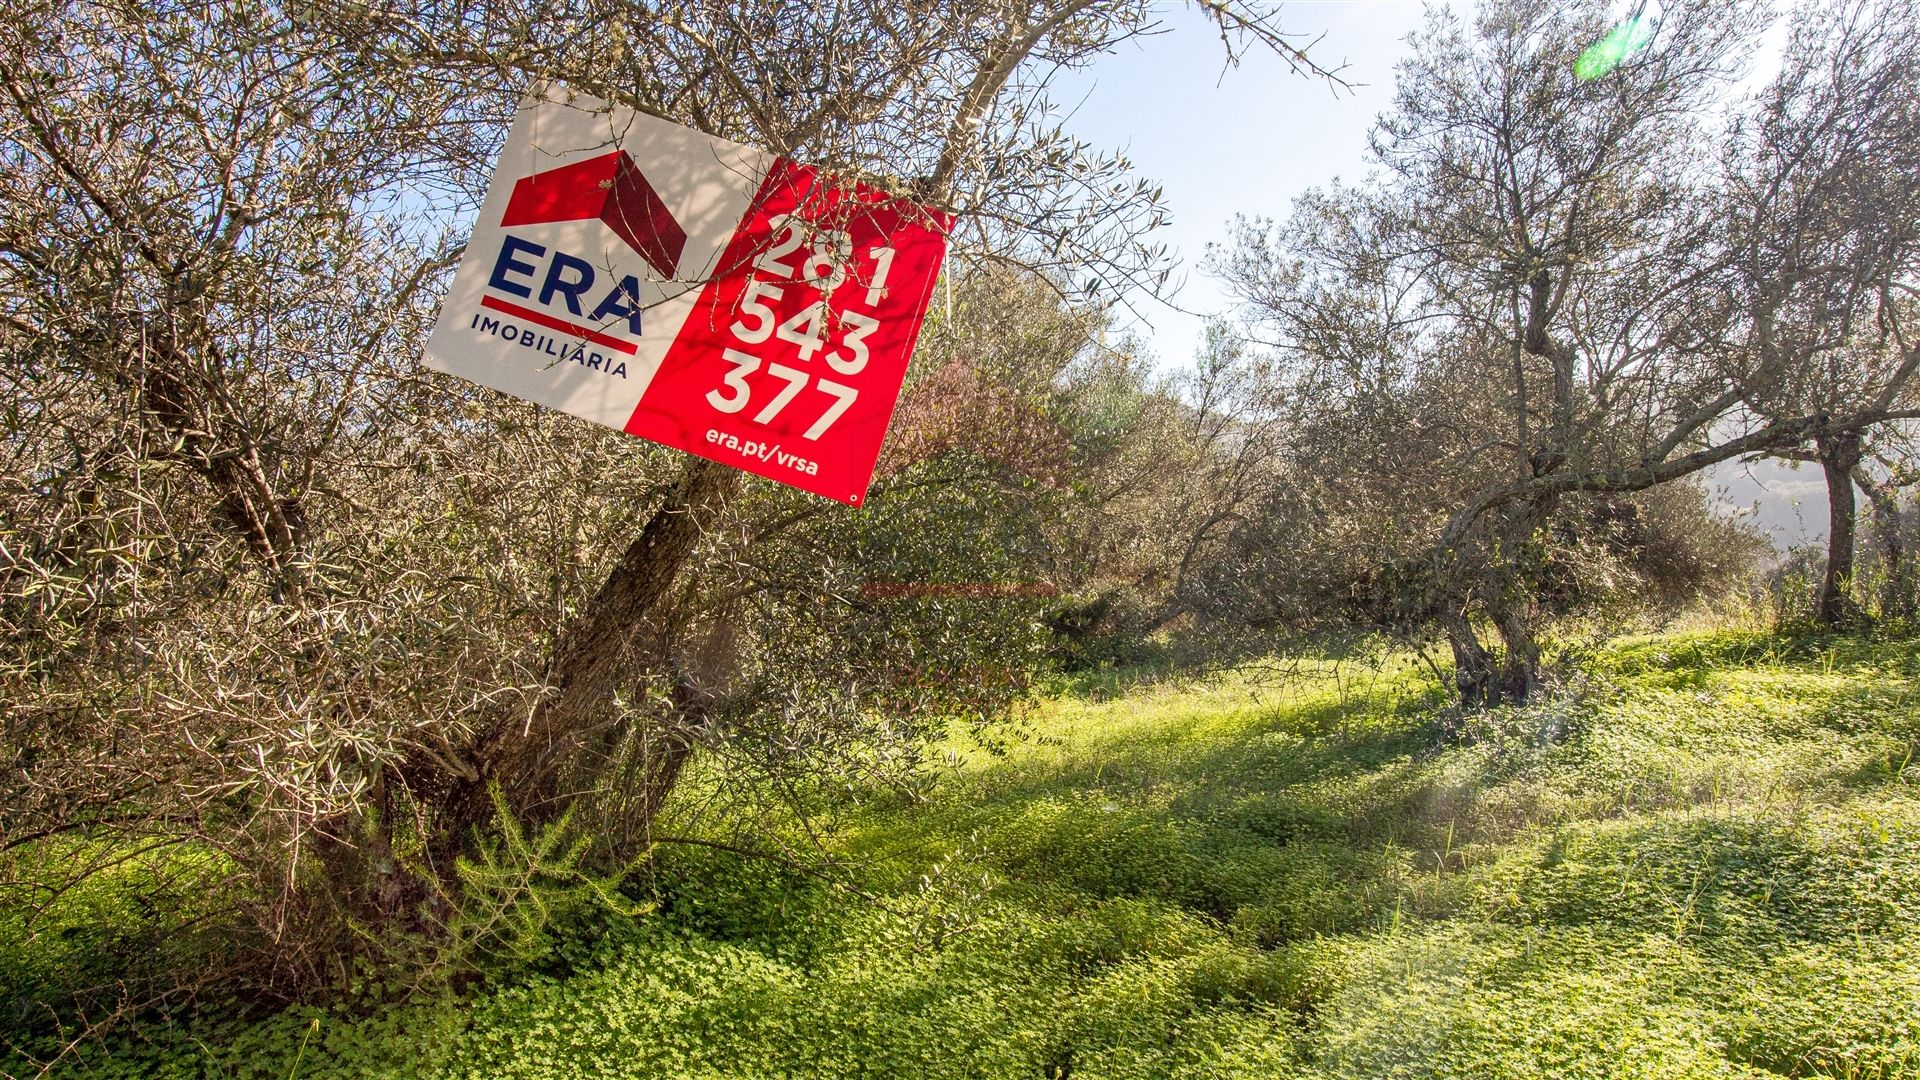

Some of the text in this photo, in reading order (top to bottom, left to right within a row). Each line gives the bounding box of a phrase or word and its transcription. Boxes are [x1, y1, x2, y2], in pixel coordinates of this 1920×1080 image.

[488, 235, 642, 336] ERA
[752, 213, 895, 307] 281
[471, 314, 627, 379] IMOBILIÁRIA
[729, 280, 880, 375] 543
[705, 347, 859, 441] 377
[705, 428, 819, 476] era.pt/vrsa
